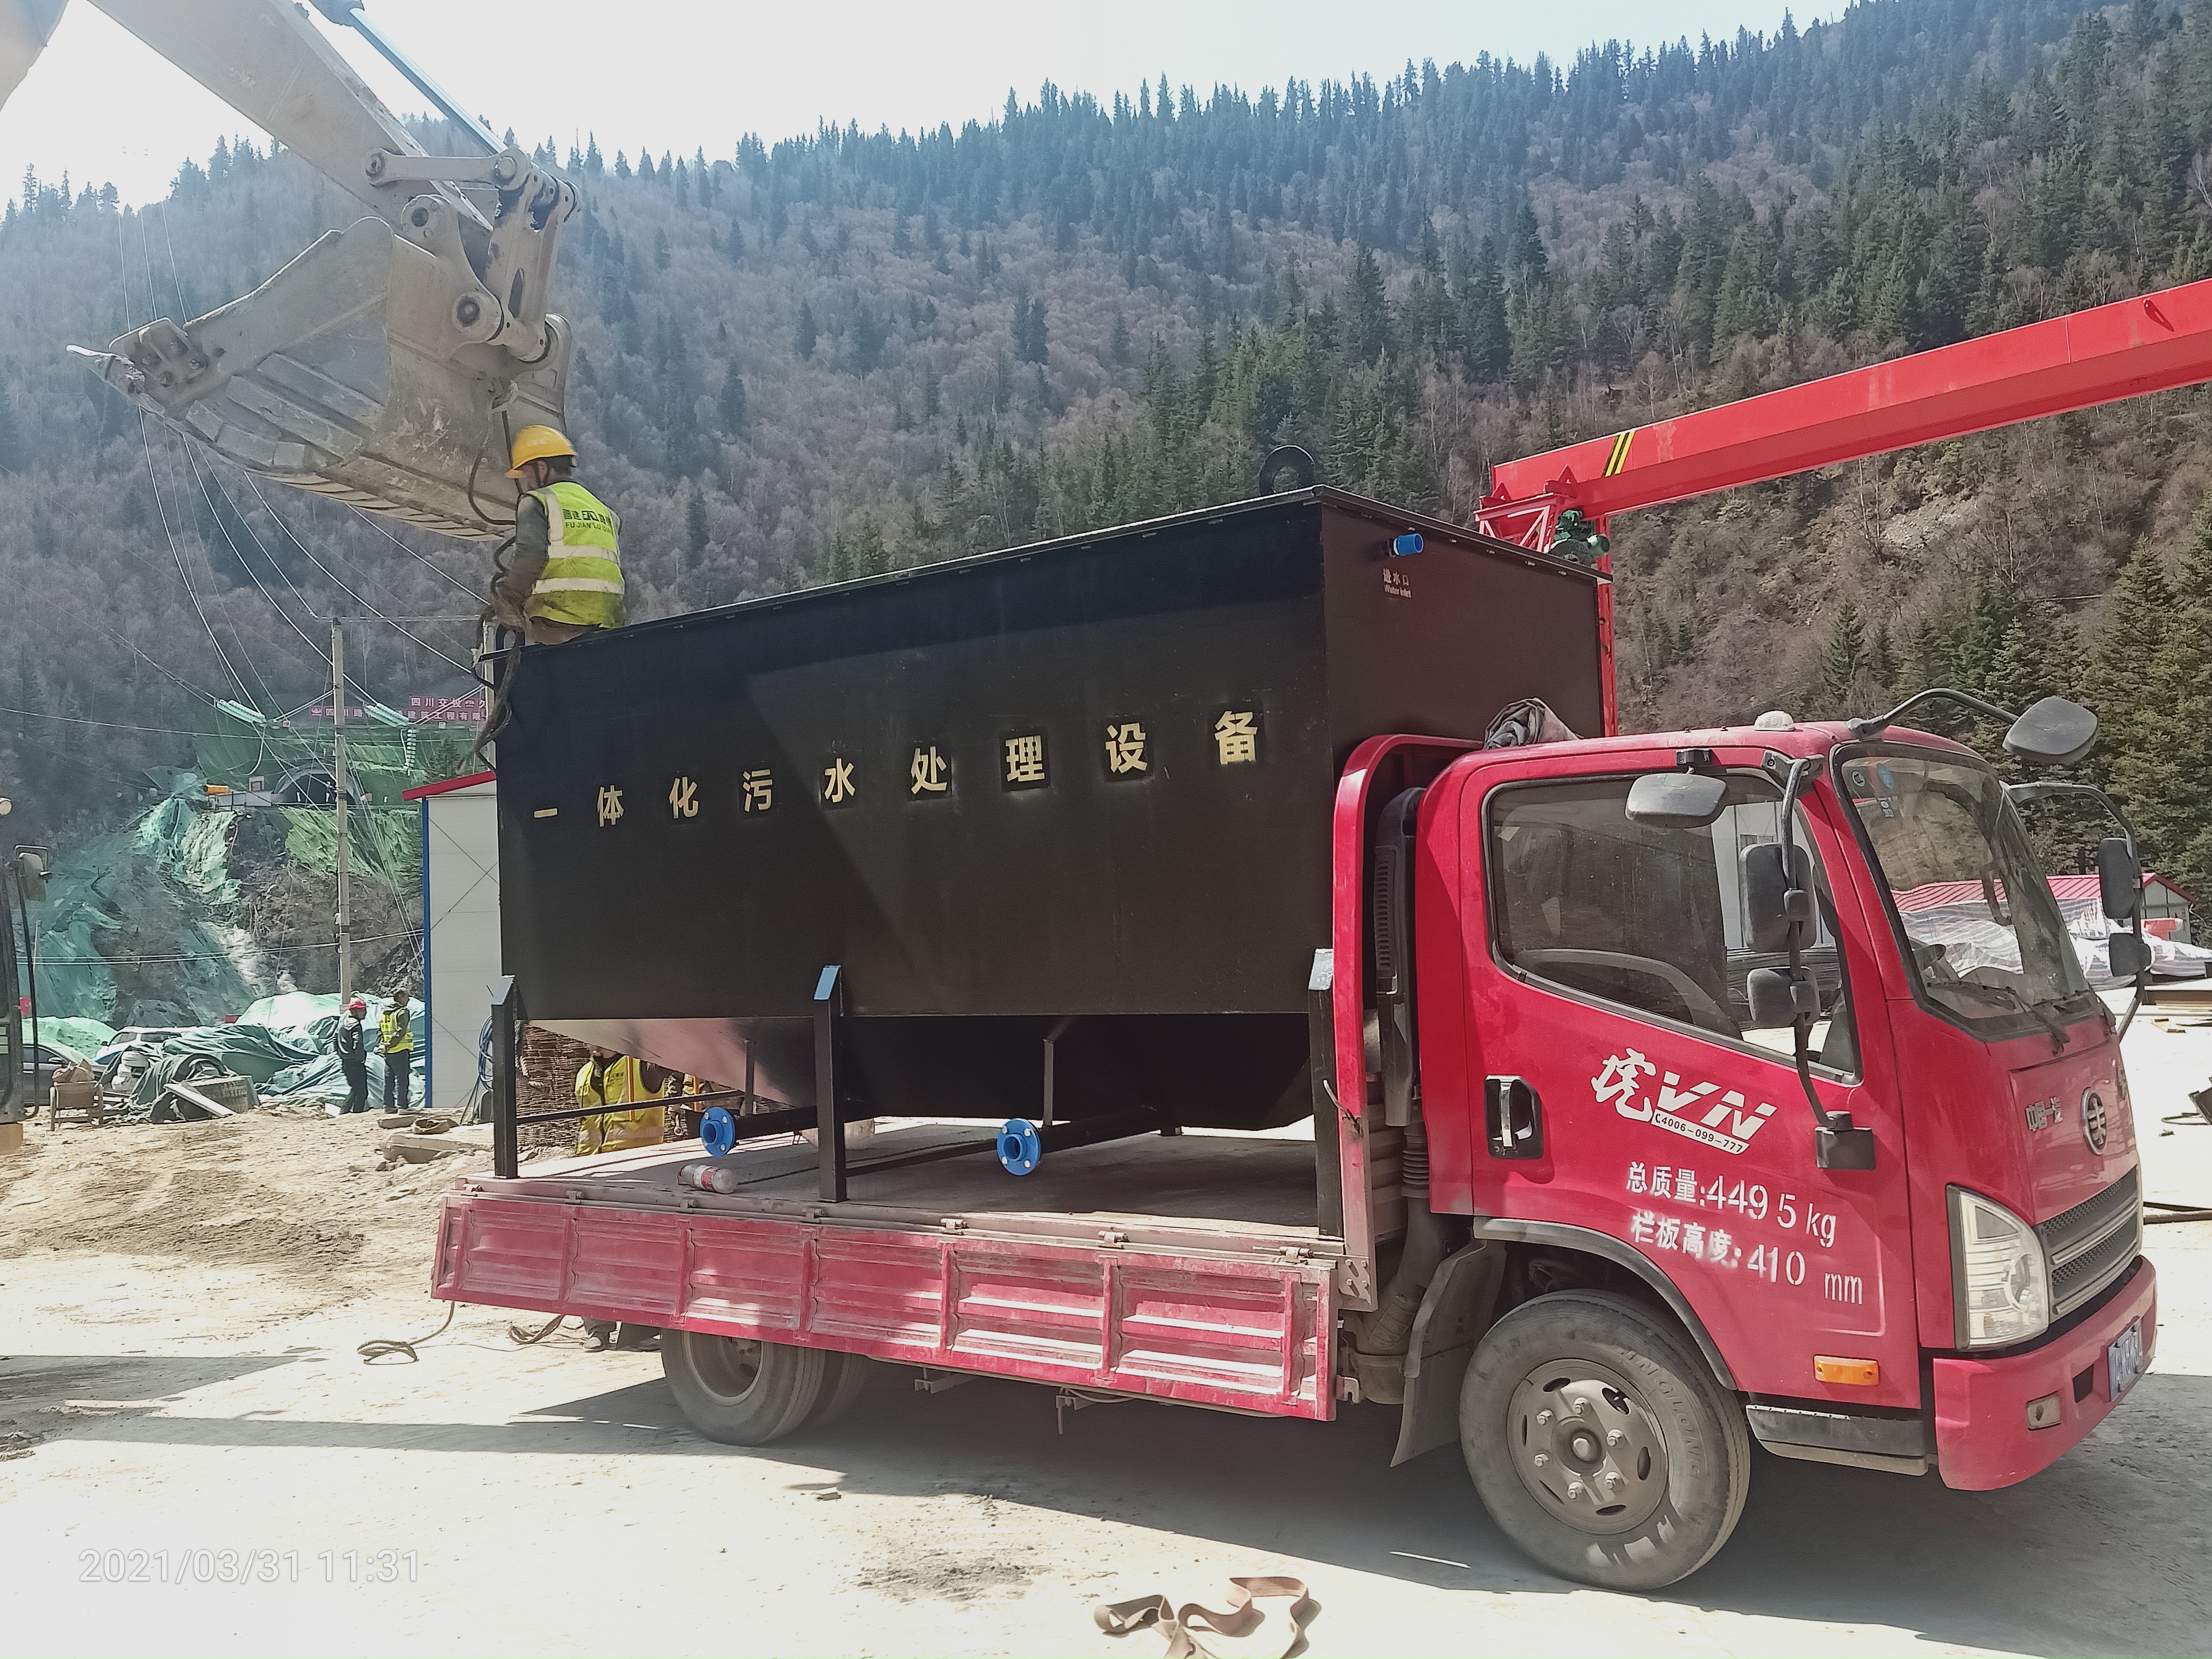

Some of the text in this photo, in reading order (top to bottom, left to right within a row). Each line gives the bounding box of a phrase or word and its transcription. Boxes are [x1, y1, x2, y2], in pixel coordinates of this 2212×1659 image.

[411, 697, 461, 708] 四川交投
[533, 709, 1258, 827] 一体化污水处理设备
[1660, 1115, 1744, 1154] 4006-099-777
[1824, 1272, 1863, 1305] mm
